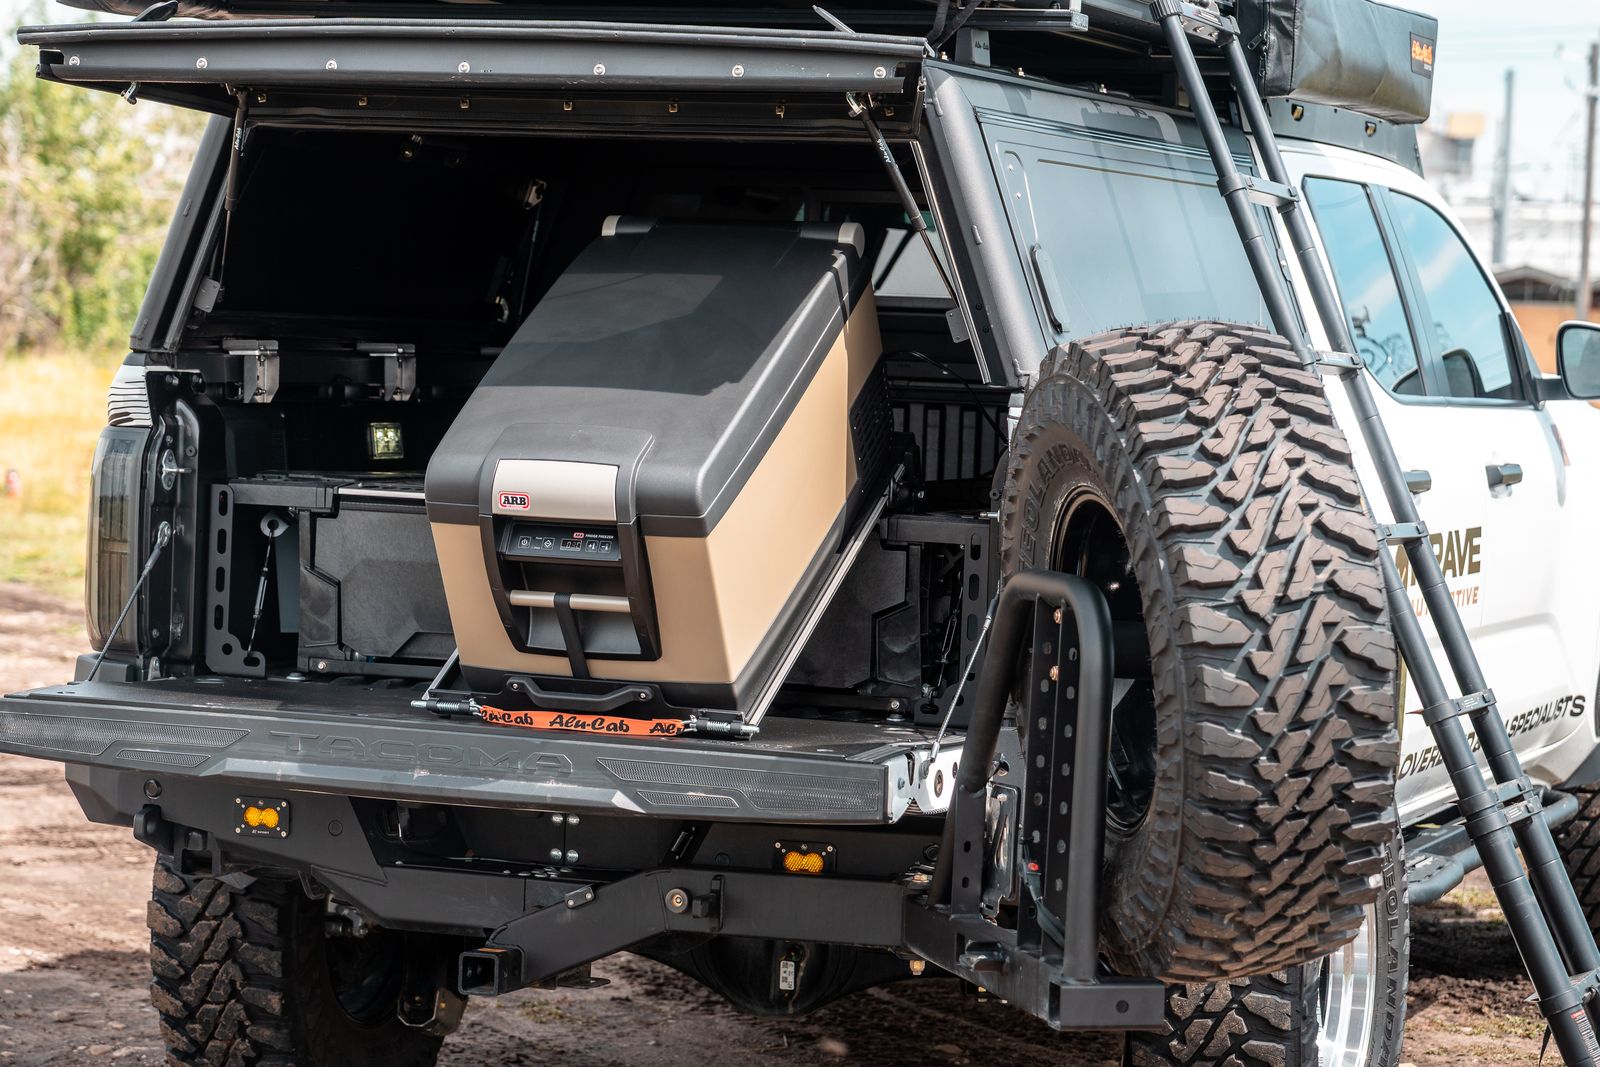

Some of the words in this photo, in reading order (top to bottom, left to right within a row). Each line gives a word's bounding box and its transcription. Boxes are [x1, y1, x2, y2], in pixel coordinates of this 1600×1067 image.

[502, 495, 527, 506] ARB
[549, 713, 630, 733] Alu-Cab
[1507, 695, 1586, 738] SPECIALISTS
[269, 730, 574, 774] TACOMA
